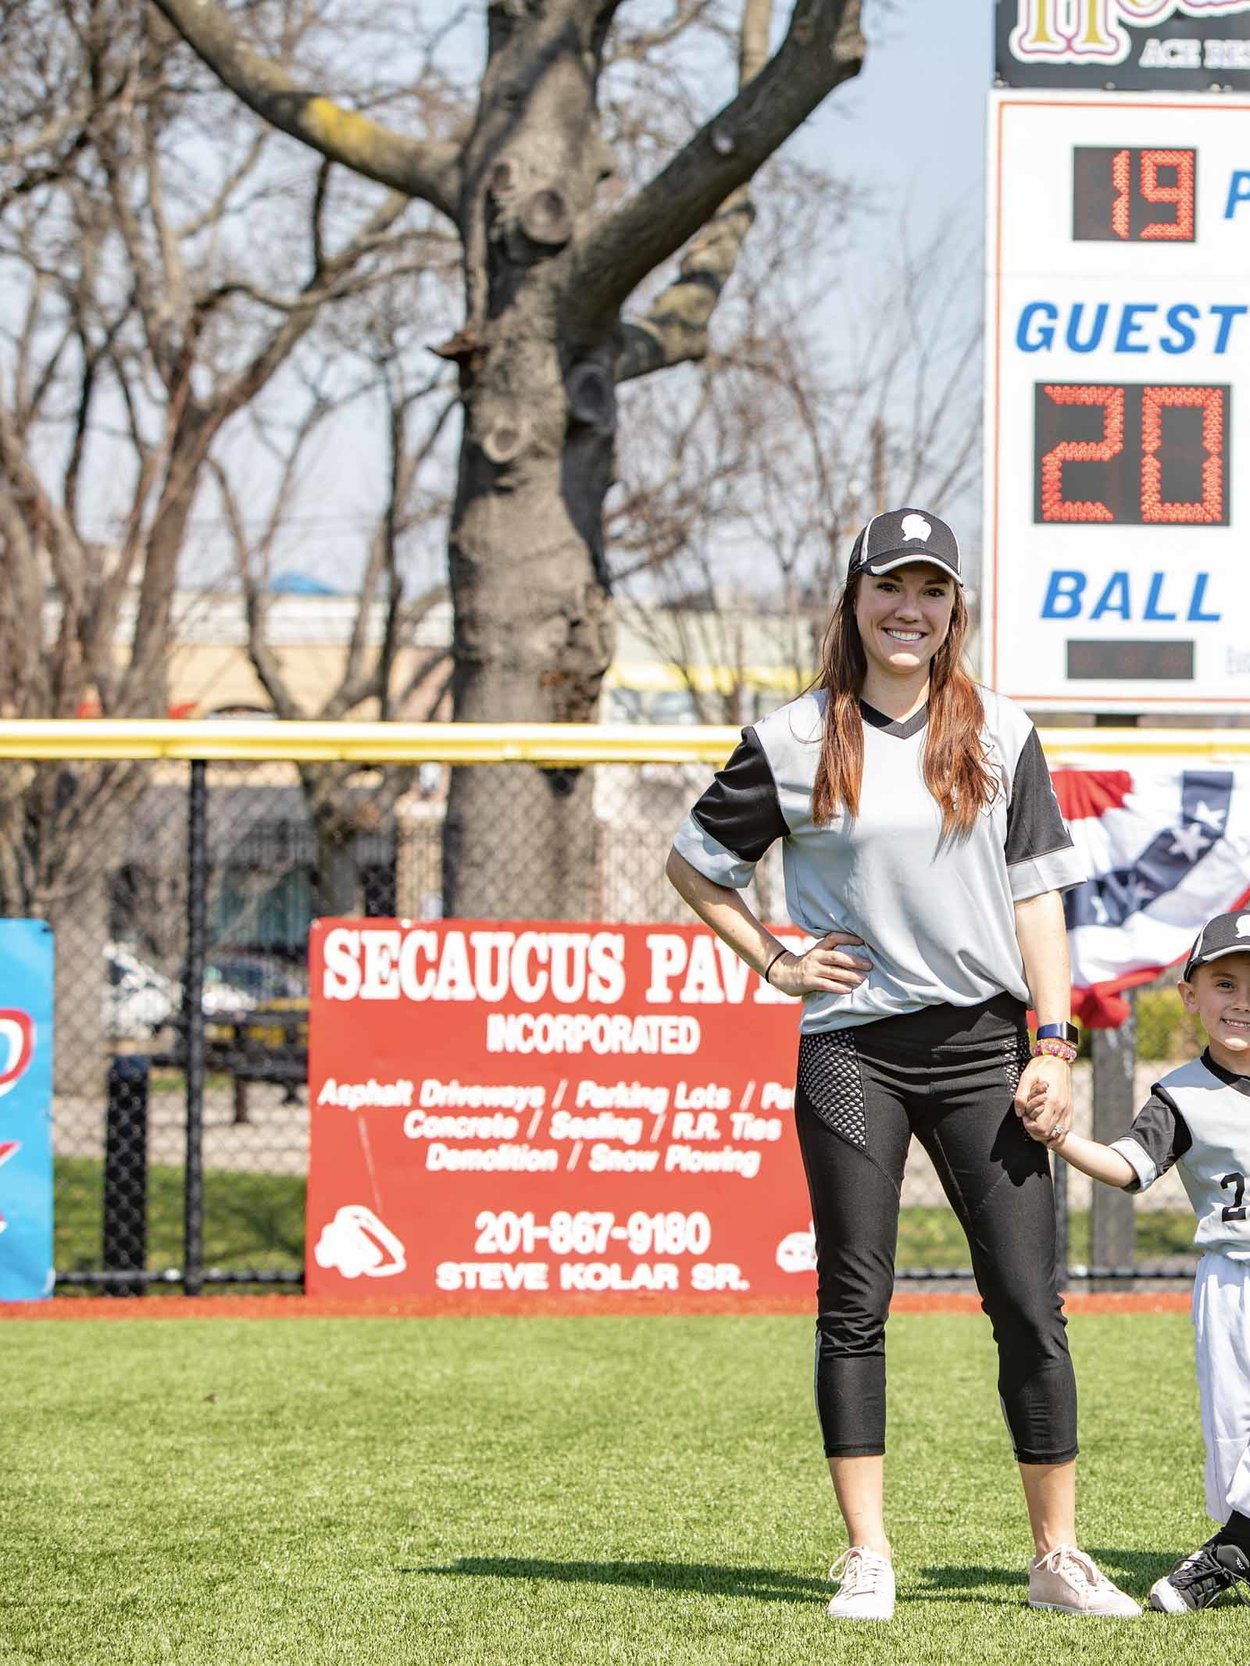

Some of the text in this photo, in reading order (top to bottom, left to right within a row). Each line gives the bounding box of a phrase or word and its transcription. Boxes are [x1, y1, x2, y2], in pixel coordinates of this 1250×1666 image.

[1139, 39, 1201, 68] ACE
[1112, 150, 1194, 240] 19
[1015, 301, 1248, 355] GUEST
[1041, 385, 1223, 522] 20
[1041, 570, 1221, 622] BALL
[324, 928, 625, 1003] SECAUCUS
[487, 1013, 700, 1054] INCORPORATED
[318, 1079, 413, 1111] Asphalt
[419, 1080, 546, 1112] Driveways
[576, 1081, 669, 1114] Parking
[675, 1081, 731, 1110] Lots
[404, 1109, 519, 1139] Concrete
[673, 1112, 720, 1140] R.R.
[731, 1112, 781, 1141] Ties
[426, 1143, 558, 1171] Demolition
[589, 1143, 659, 1172] Snow
[665, 1145, 761, 1178] Plowing
[1220, 1172, 1246, 1222] 2
[475, 1211, 710, 1255] 201-867-9180
[436, 1262, 750, 1291] STEVE KOLAR SR.
